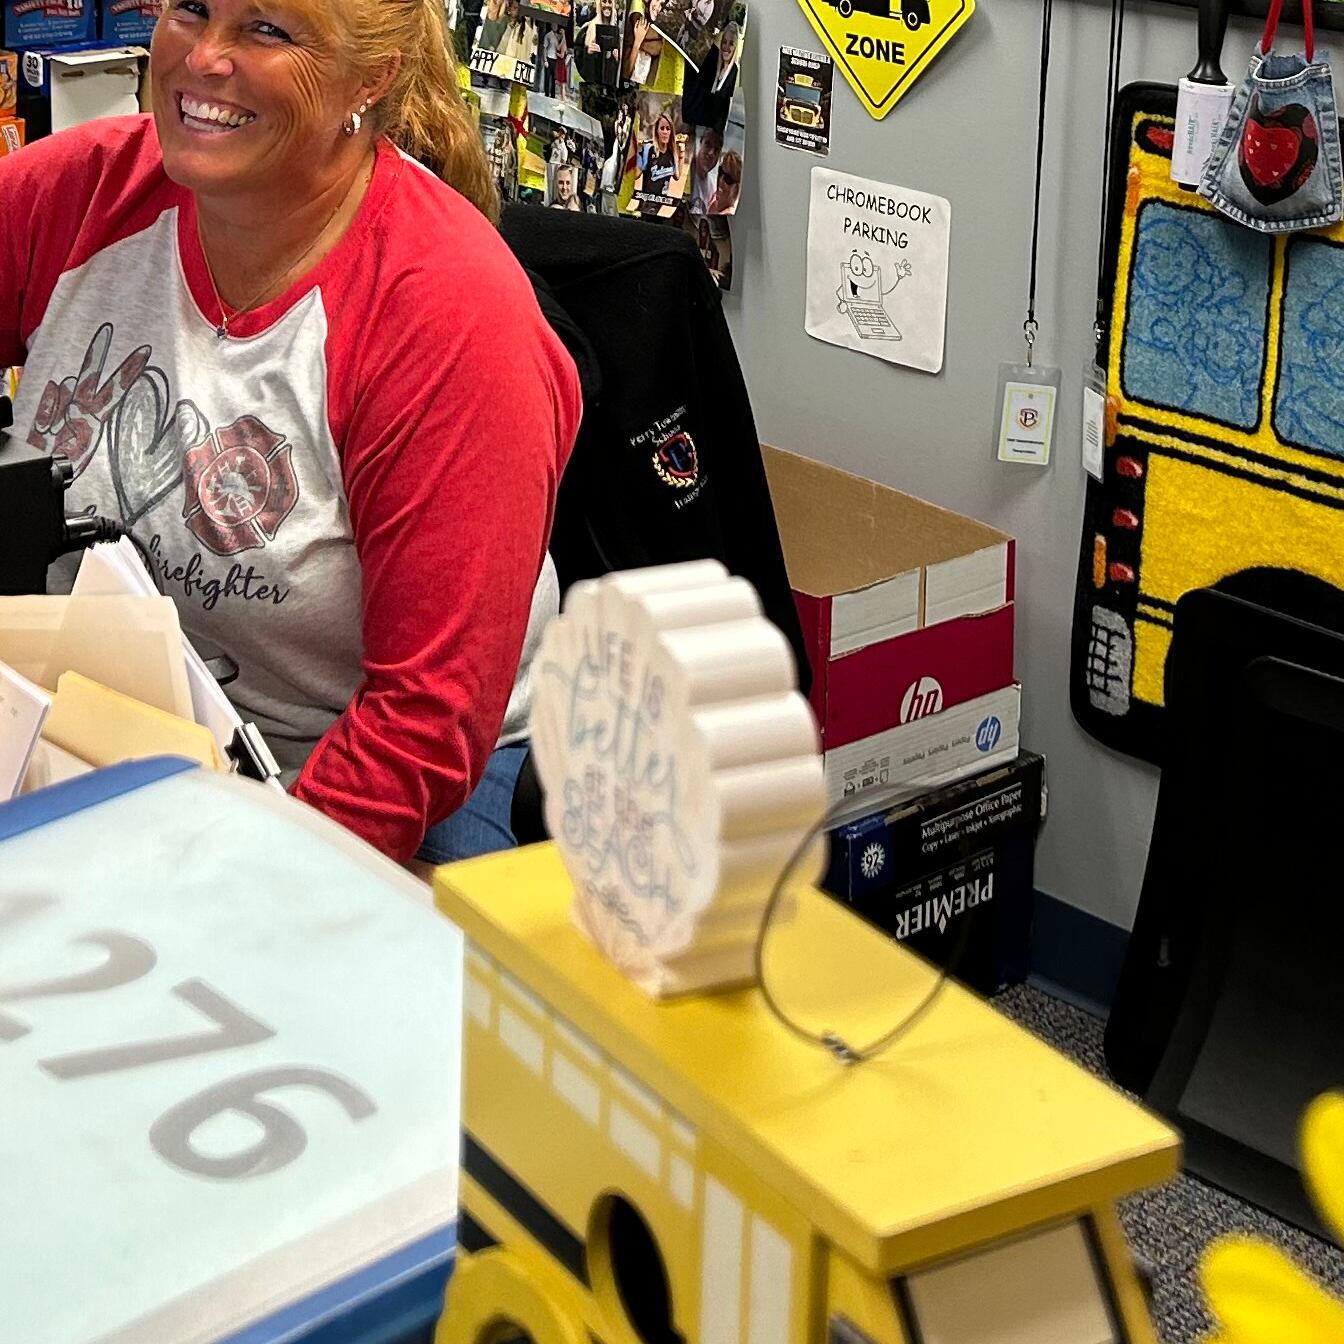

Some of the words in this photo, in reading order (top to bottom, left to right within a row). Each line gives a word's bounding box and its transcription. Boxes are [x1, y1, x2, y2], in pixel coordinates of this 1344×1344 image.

[844, 33, 907, 66] ZONE
[826, 183, 933, 226] CHROMEBOOK
[842, 217, 909, 250] PARKING
[896, 872, 994, 940] PREMIER
